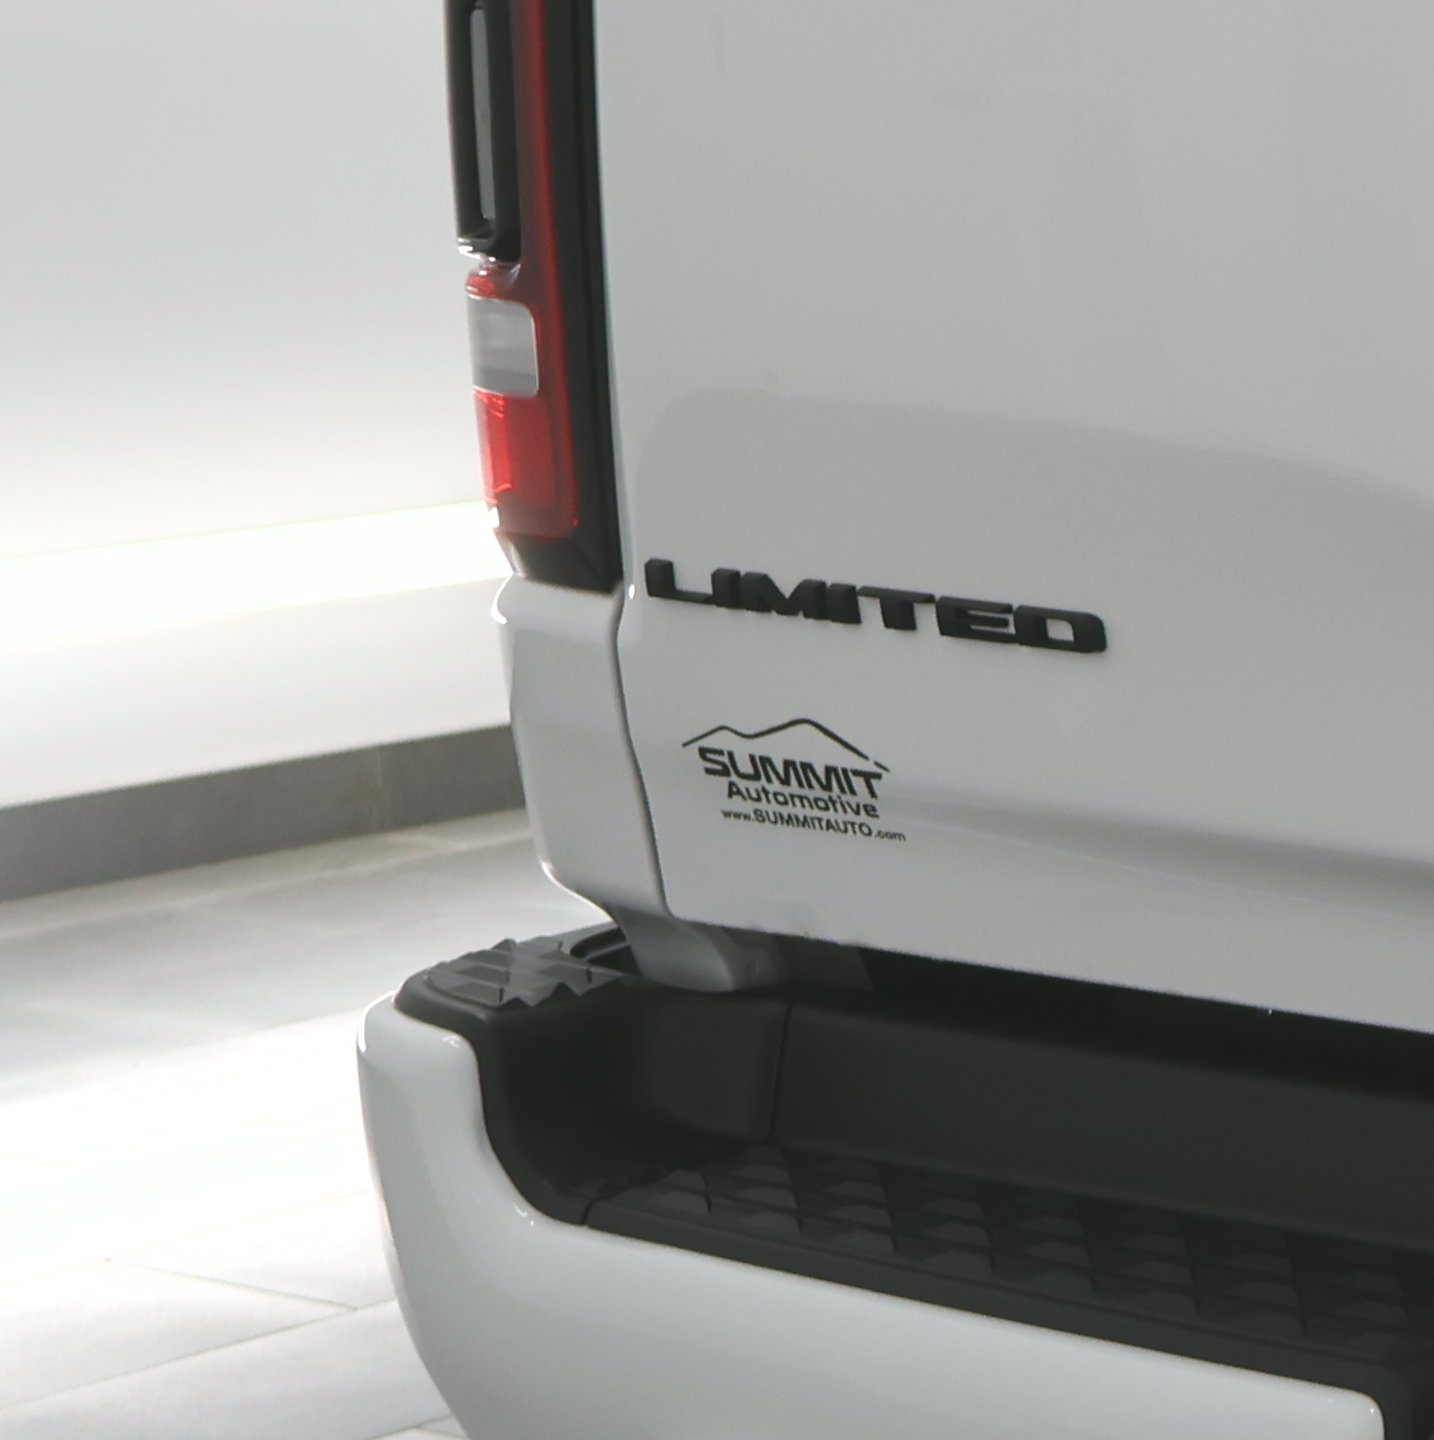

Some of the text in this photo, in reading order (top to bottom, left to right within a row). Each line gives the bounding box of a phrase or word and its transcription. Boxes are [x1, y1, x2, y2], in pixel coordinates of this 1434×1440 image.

[643, 558, 1108, 655] LIMITED
[697, 745, 883, 801] SUMMIT
[727, 779, 881, 820] Automotive
